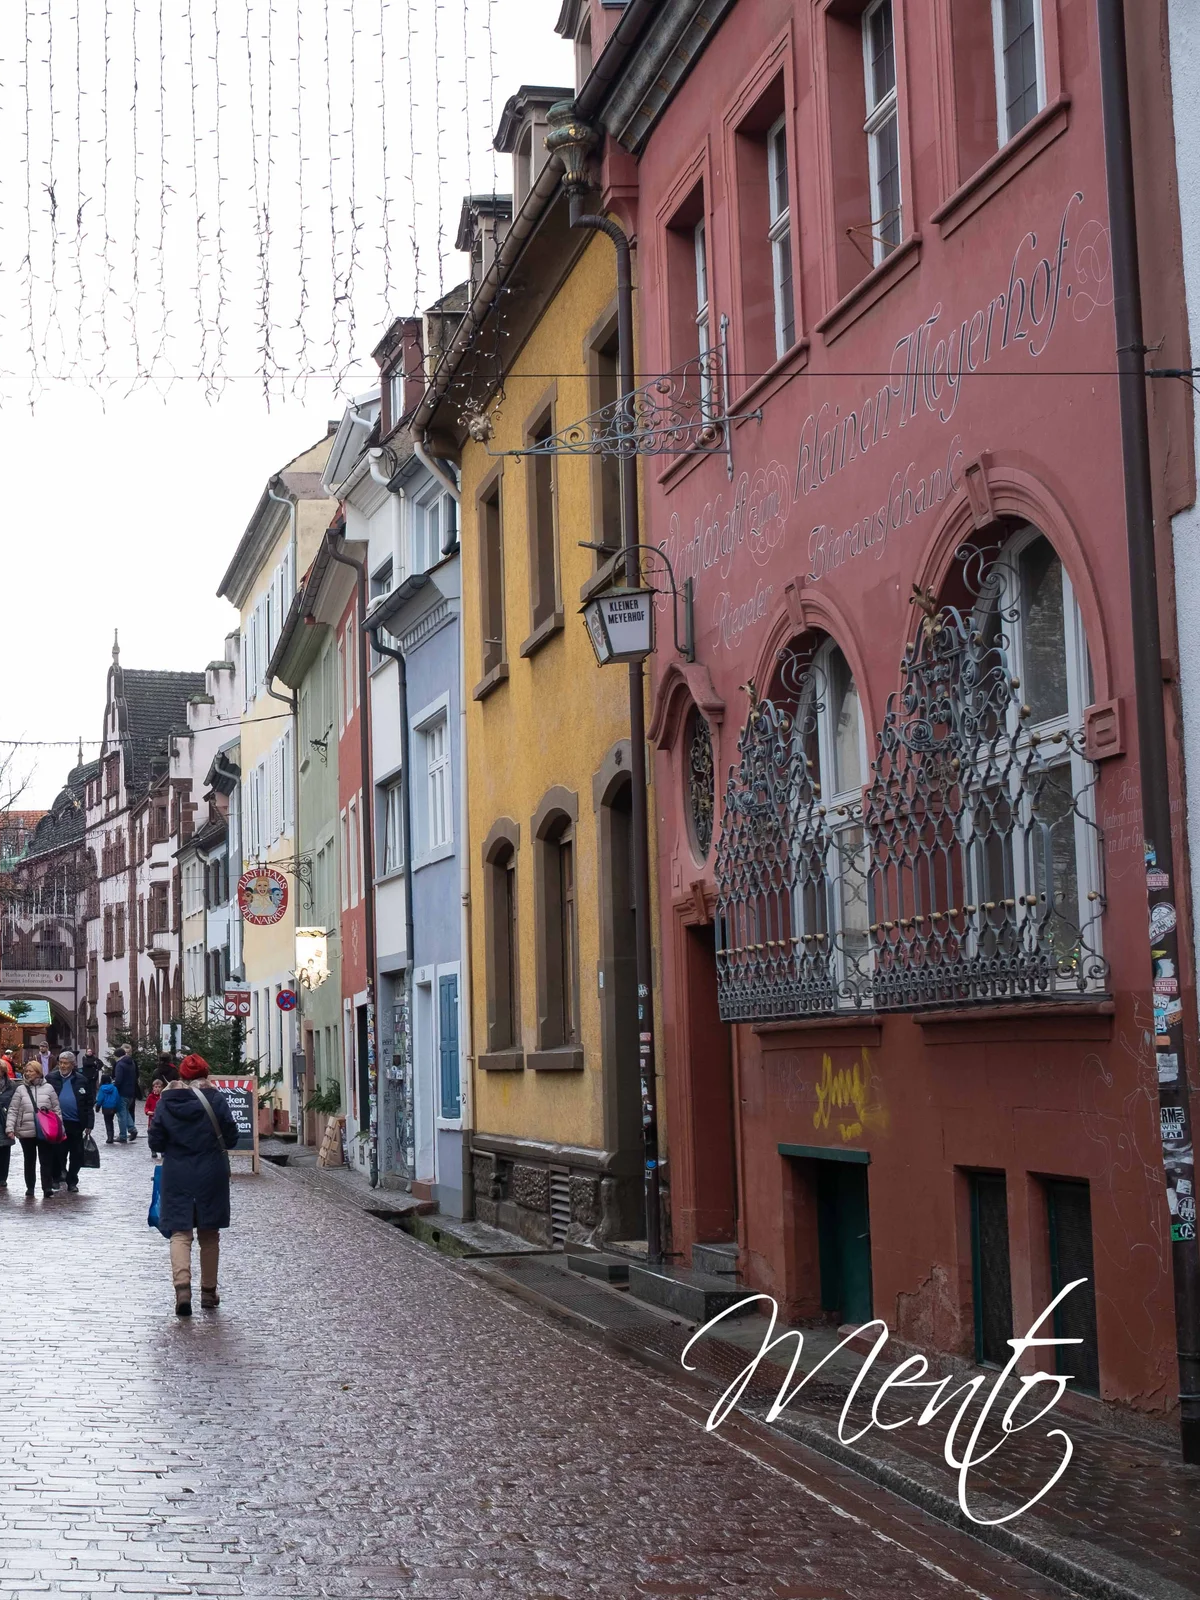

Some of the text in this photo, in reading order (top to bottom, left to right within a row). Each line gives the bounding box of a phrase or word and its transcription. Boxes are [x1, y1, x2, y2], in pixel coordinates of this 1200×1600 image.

[609, 599, 639, 612] KLEINER
[607, 611, 645, 624] MEYERHOF
[238, 869, 287, 890] ZUNFTHAUS
[240, 904, 286, 925] DER NARREN
